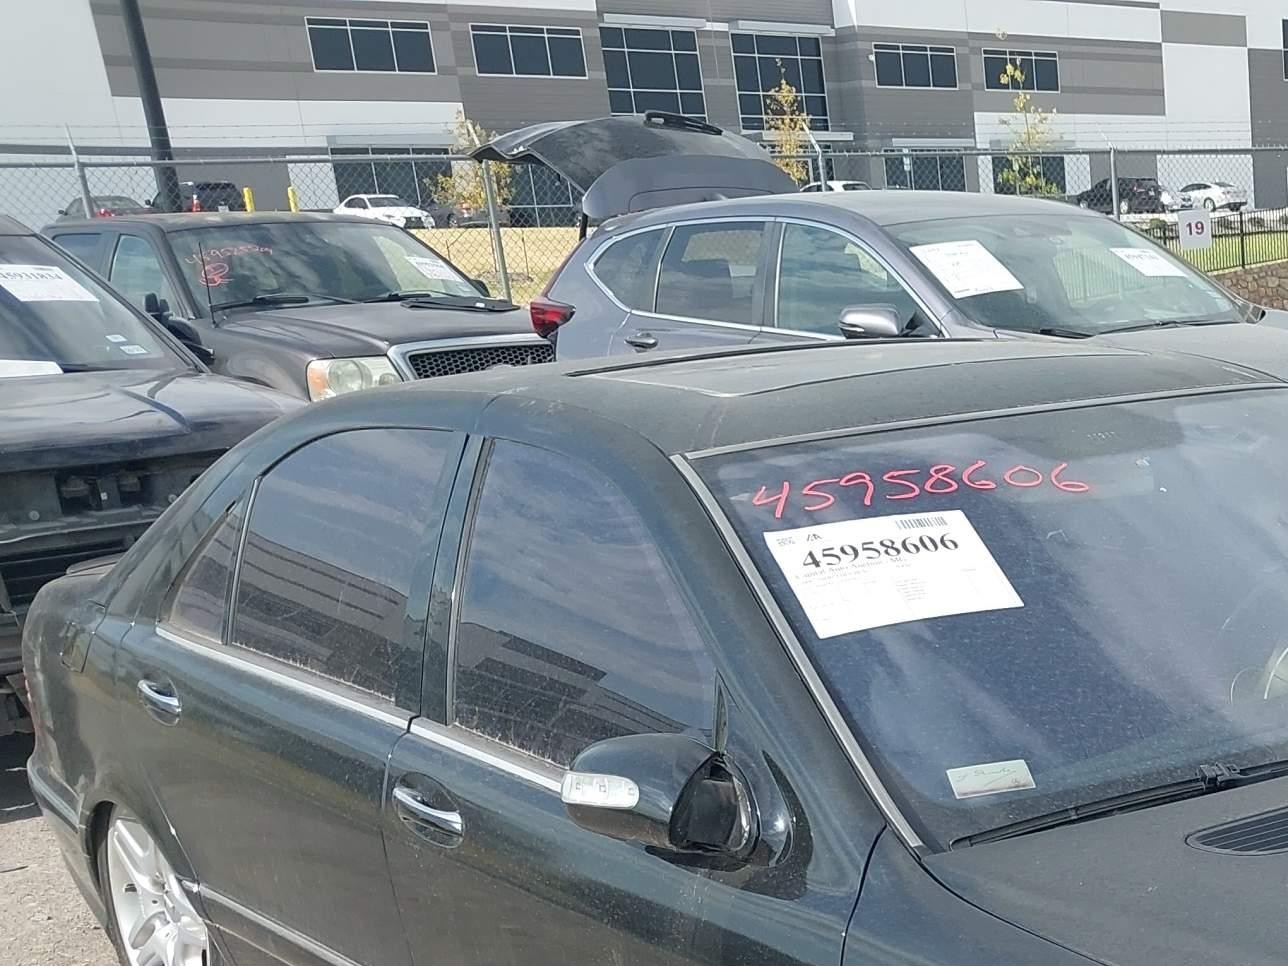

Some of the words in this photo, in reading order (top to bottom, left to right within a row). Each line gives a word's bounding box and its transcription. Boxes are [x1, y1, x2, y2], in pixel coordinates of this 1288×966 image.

[1186, 221, 1205, 236] 19
[752, 460, 1089, 519] 45958606
[803, 532, 960, 569] 45958606
